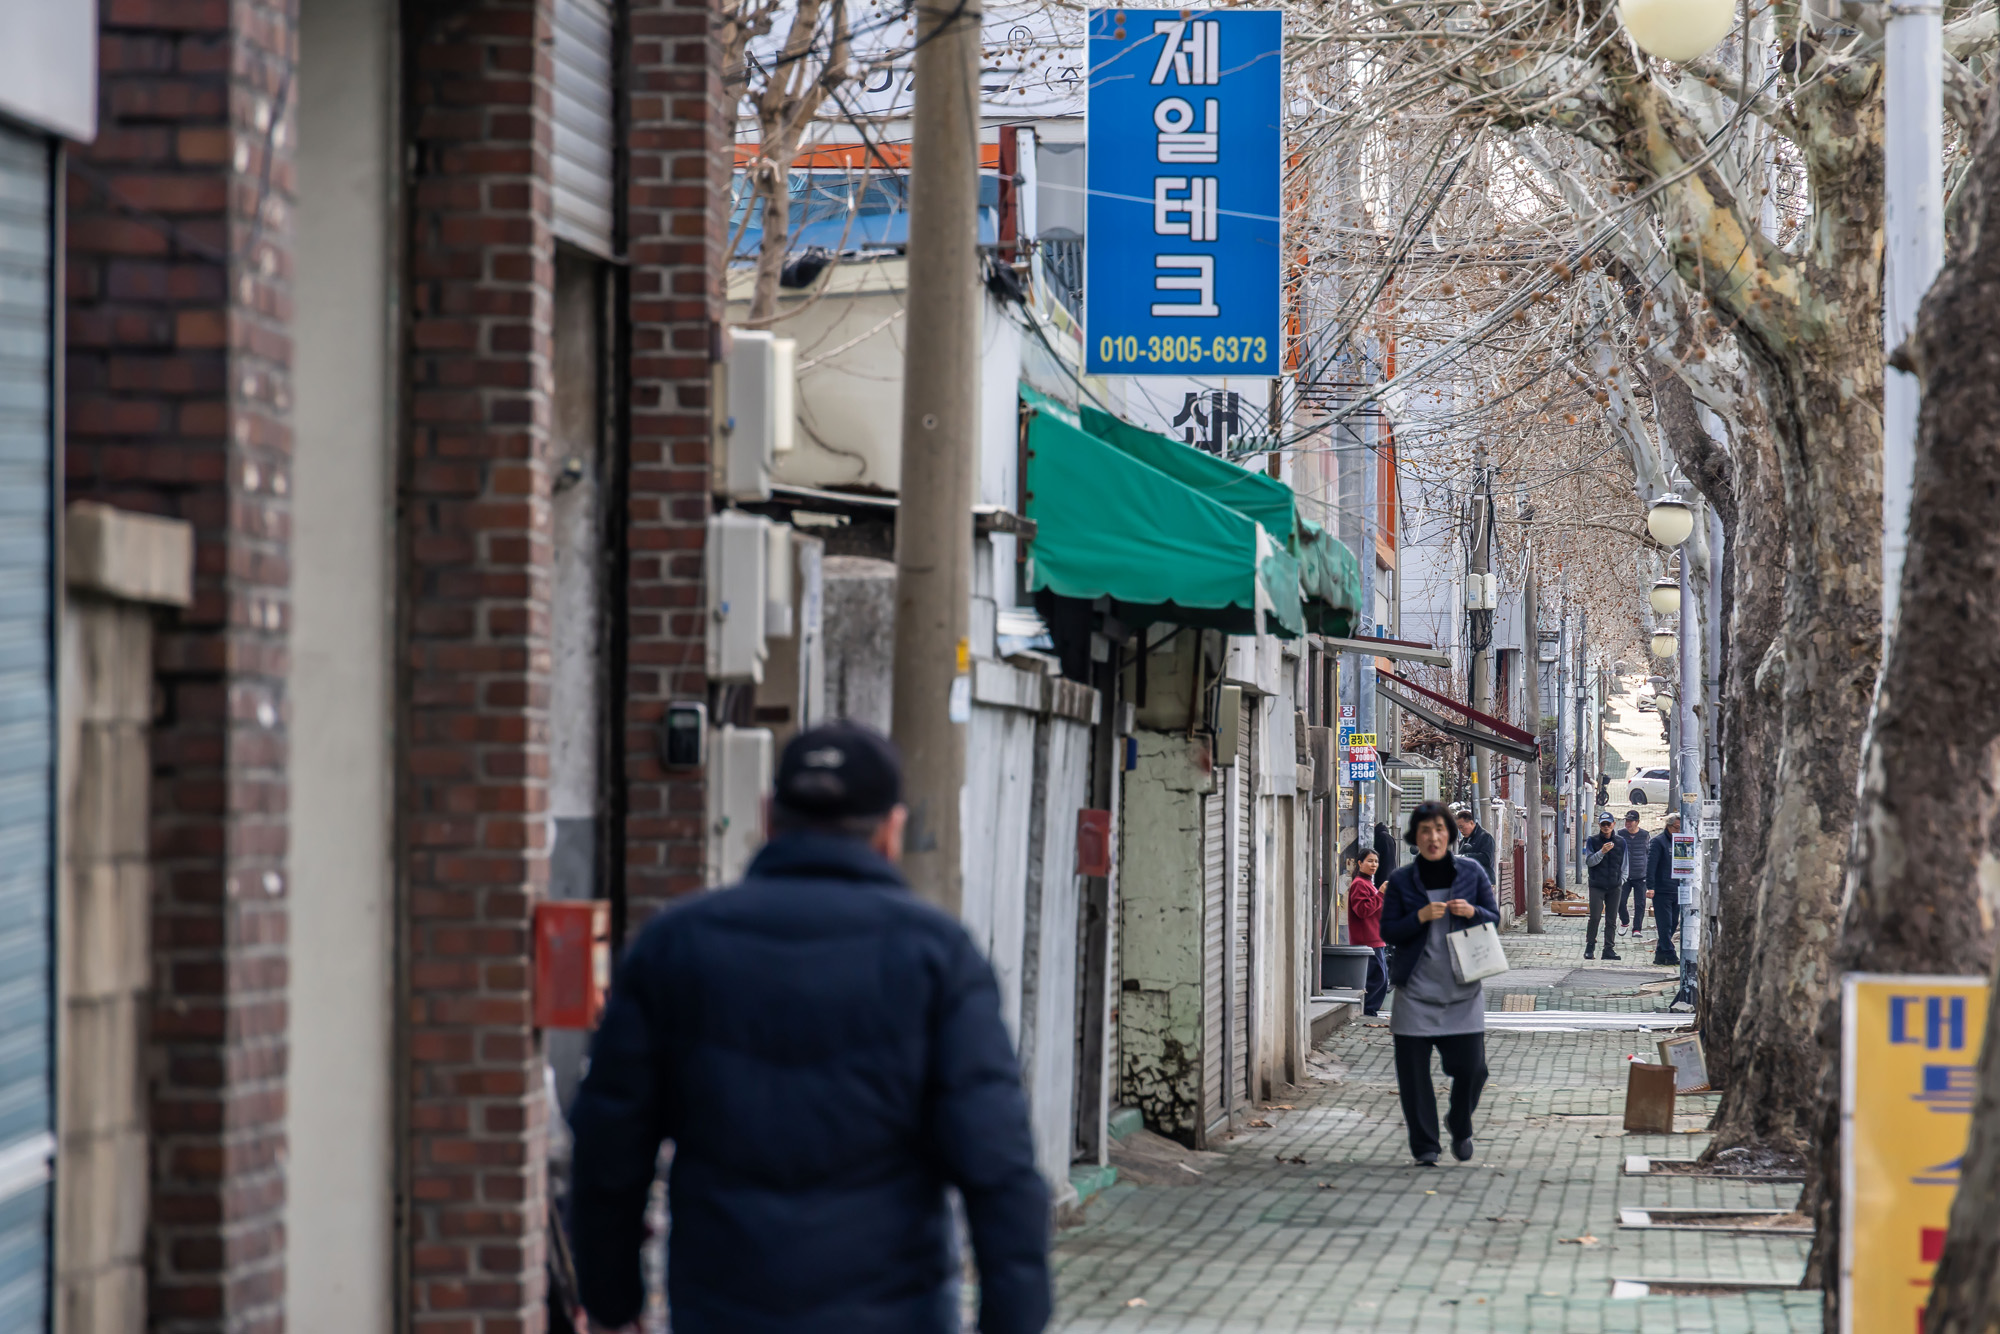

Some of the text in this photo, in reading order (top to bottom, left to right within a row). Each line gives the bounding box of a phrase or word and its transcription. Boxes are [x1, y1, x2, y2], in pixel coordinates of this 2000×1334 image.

[1151, 19, 1220, 318] 제일테크
[1099, 335, 1268, 365] 010-3805-6373
[1351, 762, 1374, 771] 586-
[1351, 770, 1375, 779] 2500
